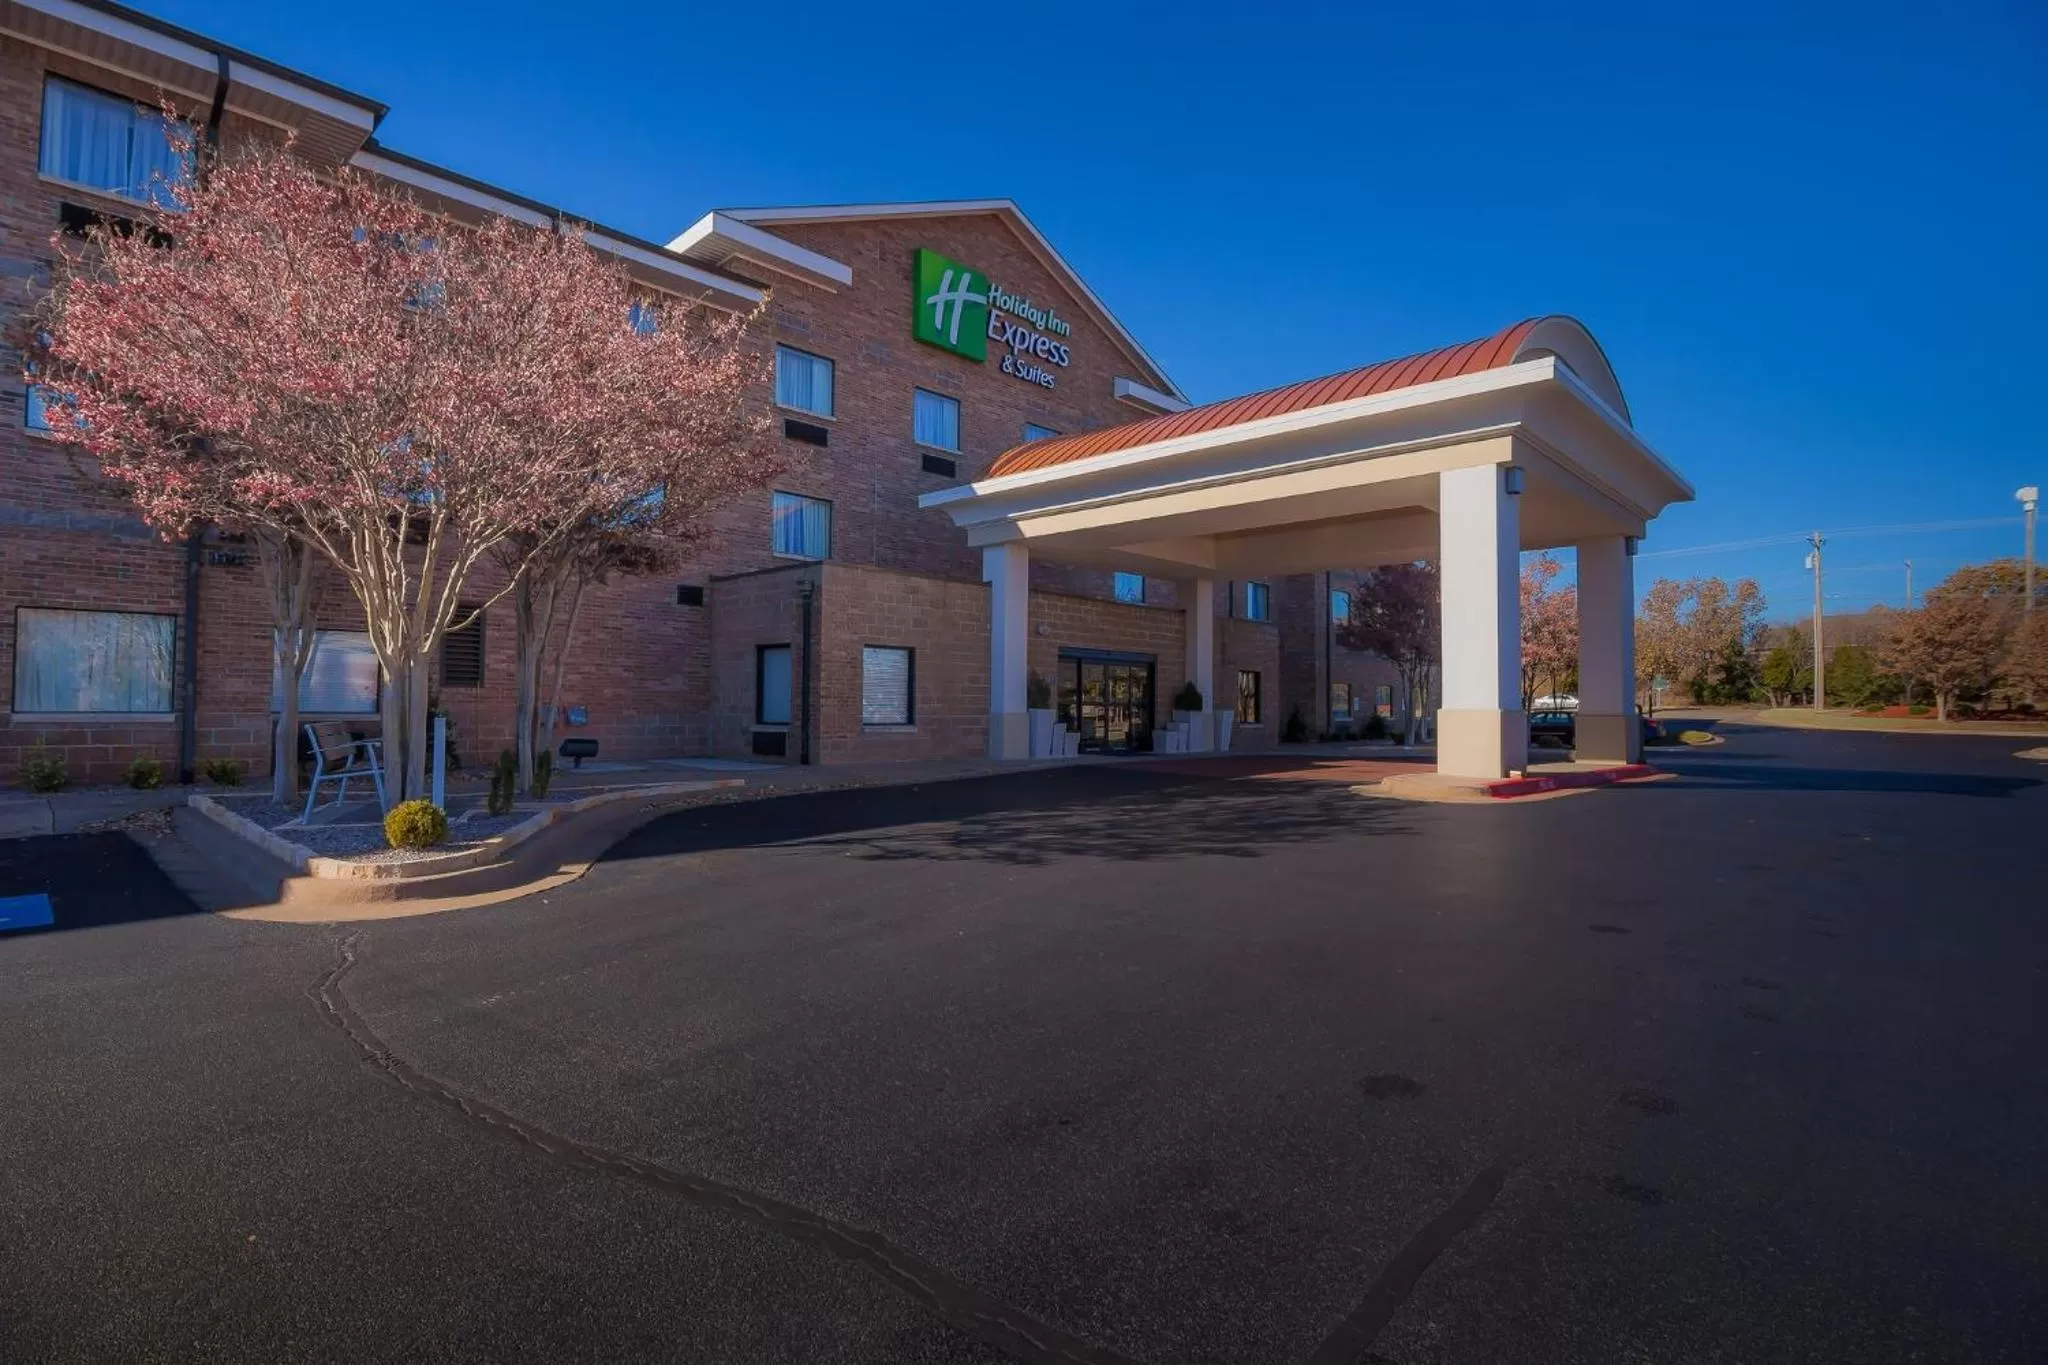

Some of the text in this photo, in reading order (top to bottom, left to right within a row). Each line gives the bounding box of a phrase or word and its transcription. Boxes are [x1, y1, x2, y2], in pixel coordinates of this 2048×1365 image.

[989, 284, 1071, 336] Holiday Inn
[987, 309, 1070, 367] Express
[1002, 355, 1055, 389] & Suites
